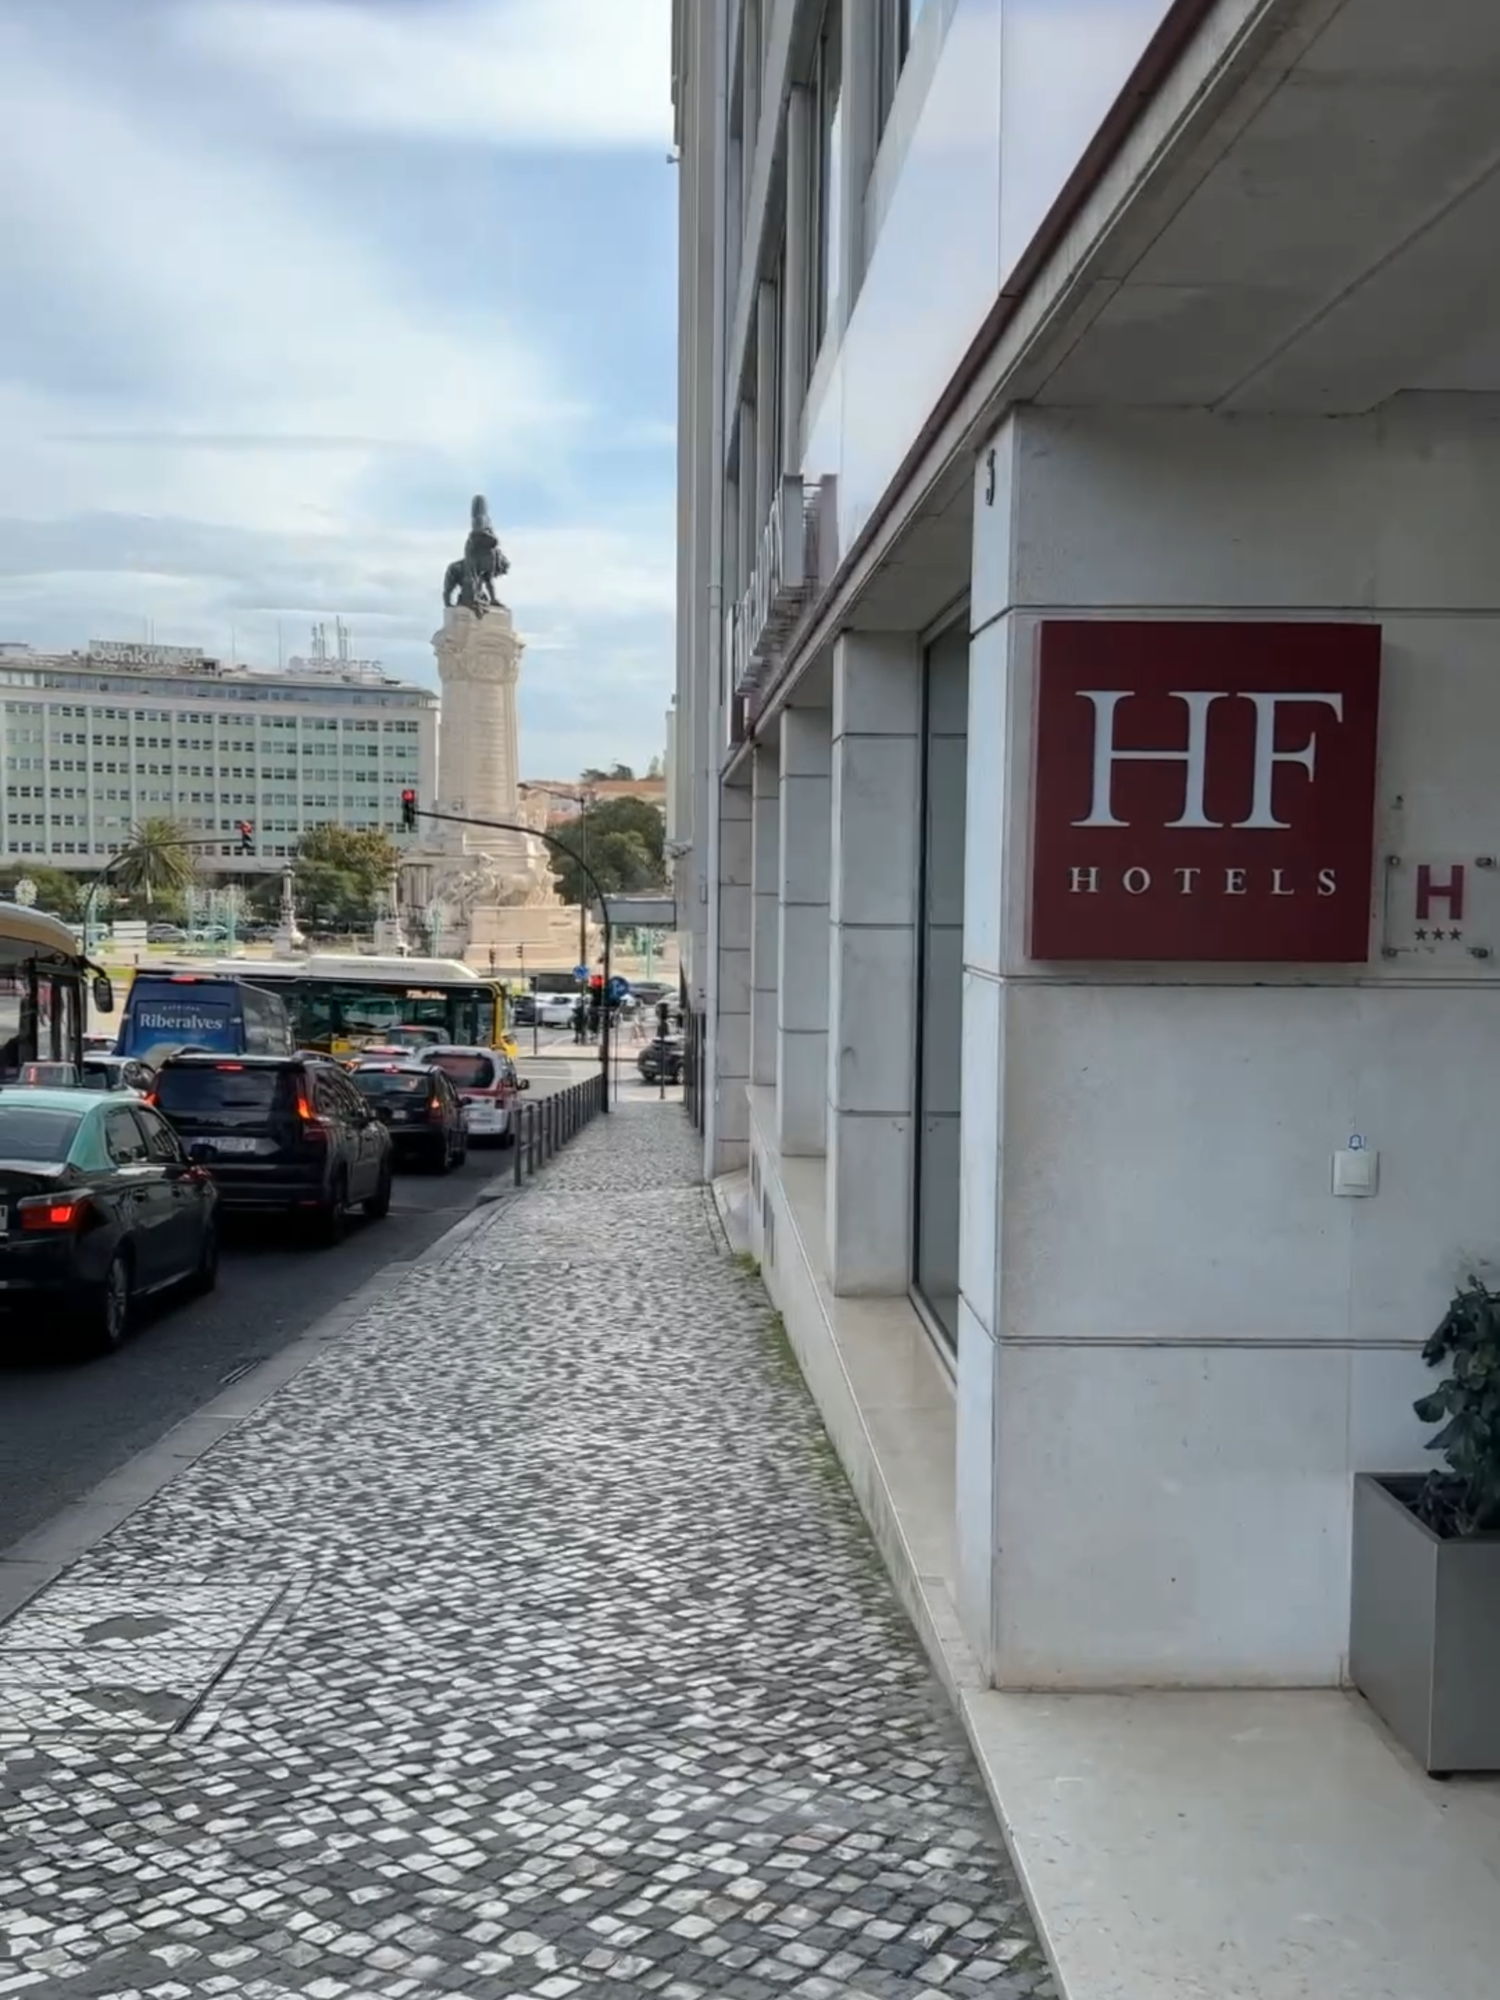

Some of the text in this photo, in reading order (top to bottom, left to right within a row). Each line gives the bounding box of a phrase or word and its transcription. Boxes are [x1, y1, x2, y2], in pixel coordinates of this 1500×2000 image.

[1070, 690, 1344, 829] HF
[1068, 866, 1338, 896] HOTELS
[1415, 864, 1465, 920] H
[139, 1012, 223, 1030] Riberalves
